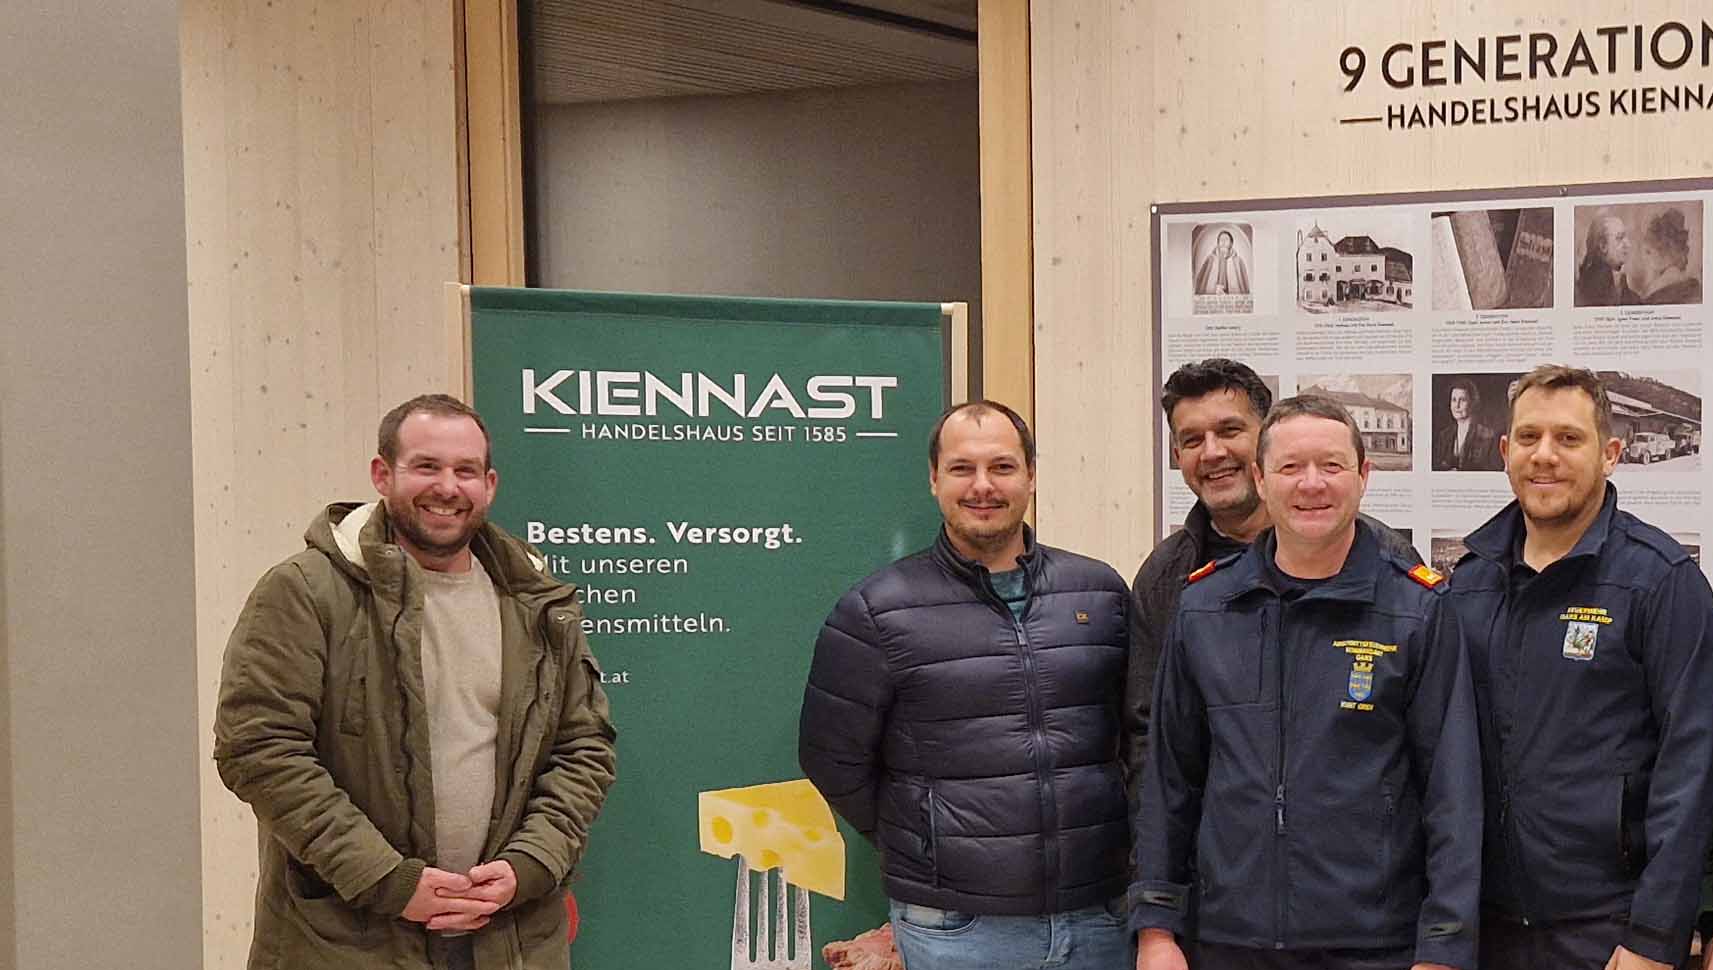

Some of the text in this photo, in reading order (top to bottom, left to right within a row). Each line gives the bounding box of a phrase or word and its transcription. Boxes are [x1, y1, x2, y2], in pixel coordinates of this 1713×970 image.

[1339, 46, 1366, 92] 9
[1387, 91, 1601, 130] HANDELSHAUS
[522, 368, 898, 419] KIENNAST
[582, 423, 847, 442] HANDELSHAUS SEIT 1585
[527, 521, 803, 549] Bestens. Versorgt.
[543, 554, 688, 574] it unseren
[576, 583, 636, 604] chen
[580, 612, 731, 634] ensmitteln.
